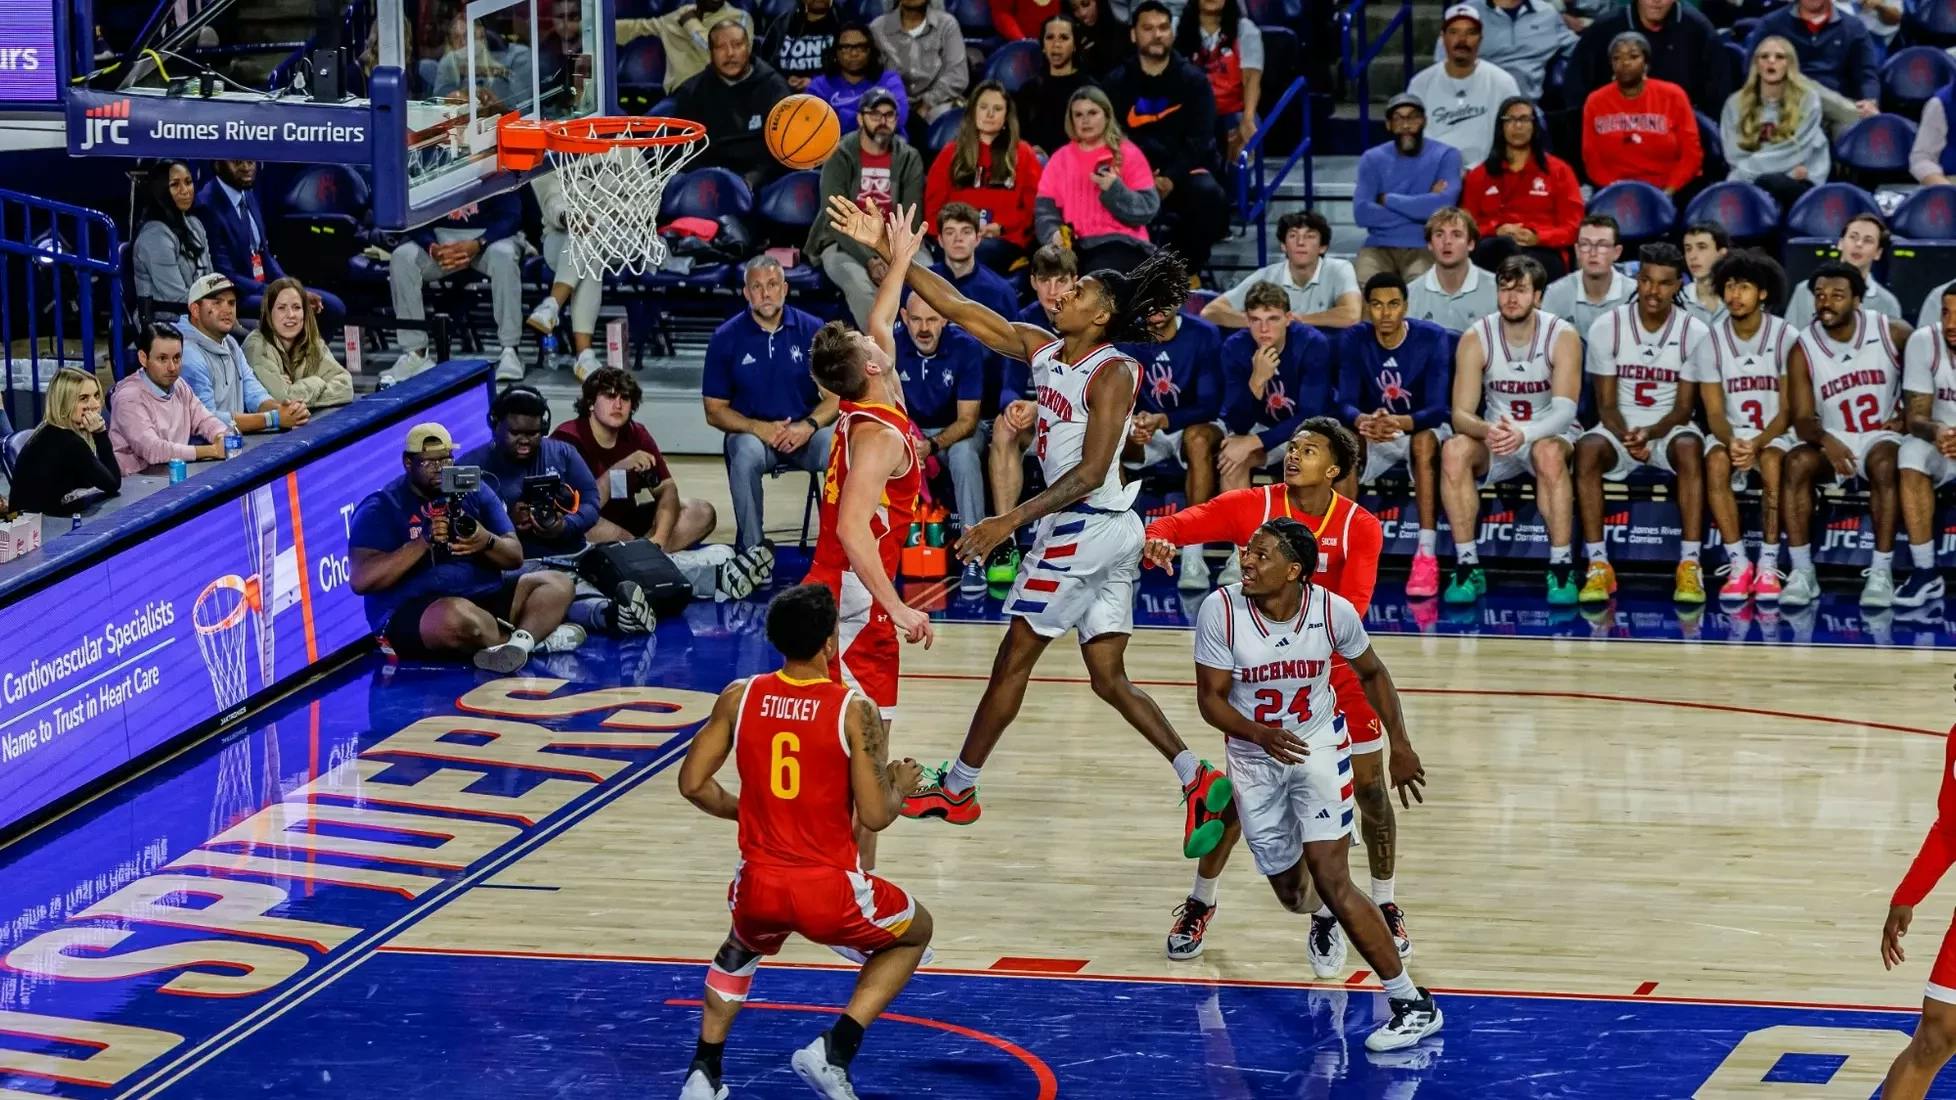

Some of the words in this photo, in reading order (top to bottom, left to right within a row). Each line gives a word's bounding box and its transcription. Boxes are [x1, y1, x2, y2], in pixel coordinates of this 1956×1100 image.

[81, 117, 130, 150] jrc
[150, 119, 219, 141] James
[225, 119, 278, 141] River
[283, 121, 366, 143] Carriers
[1634, 382, 1658, 408] 5
[1820, 369, 1888, 400] RICHMOND
[1511, 400, 1533, 422] 9
[1740, 399, 1765, 430] 3
[1839, 393, 1882, 433] 12
[1476, 523, 1513, 544] jrc
[1603, 525, 1627, 543] rc
[1630, 526, 1659, 535] James
[1820, 530, 1859, 551] jrc
[319, 553, 351, 592] Cho
[3, 635, 104, 705] Cardiovascular
[105, 600, 175, 657] Specialists
[1242, 659, 1326, 684] RICHMOND
[1, 728, 37, 763] Name
[40, 720, 52, 744] to
[53, 700, 86, 735] Trust
[86, 693, 98, 720] in
[99, 676, 133, 713] Heart
[134, 665, 160, 695] Care
[760, 694, 821, 721] STUCKEY
[1254, 684, 1313, 729] 24
[770, 731, 801, 800] 6
[2, 677, 722, 998] SPIDERS
